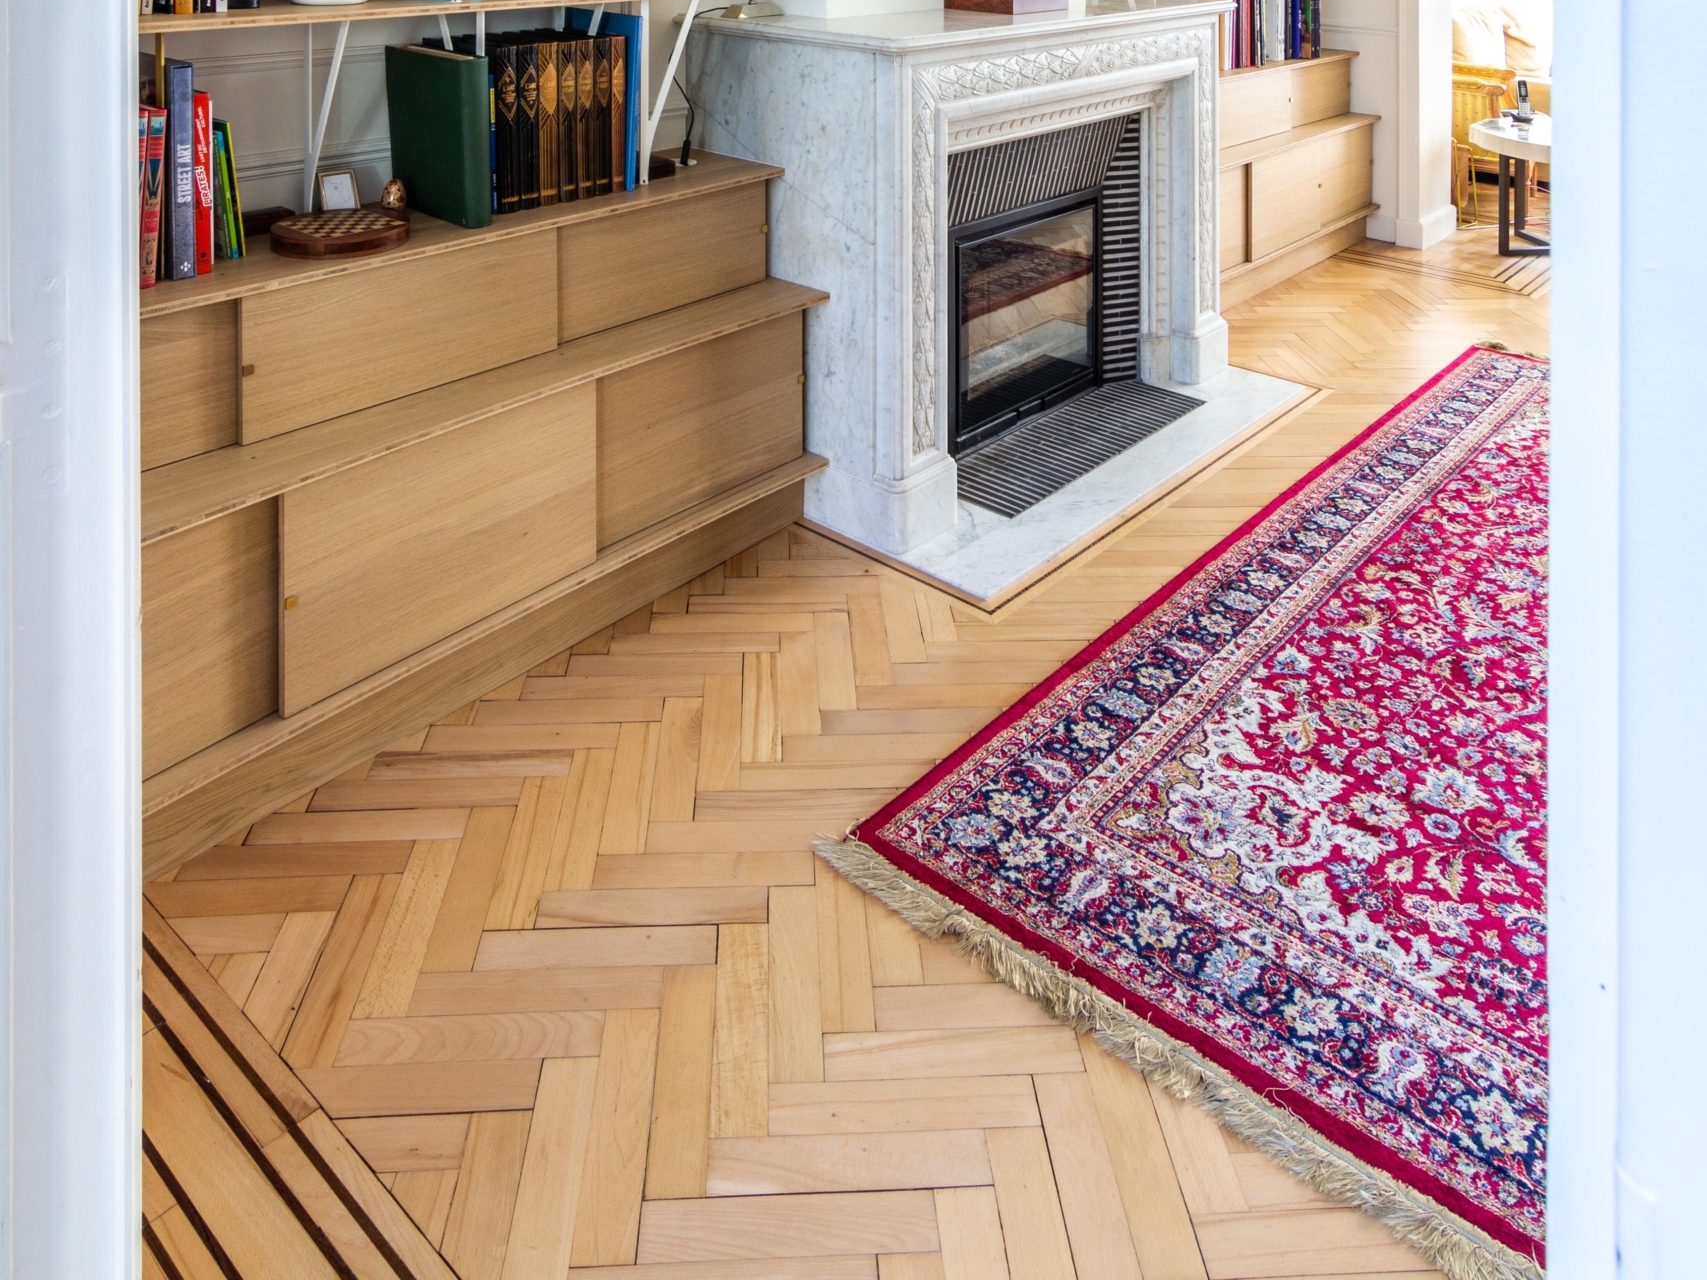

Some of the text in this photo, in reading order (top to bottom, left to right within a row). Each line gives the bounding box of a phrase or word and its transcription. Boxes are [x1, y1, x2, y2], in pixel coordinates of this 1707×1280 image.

[177, 144, 191, 203] STREET ART
[194, 166, 212, 206] PIRATES!
